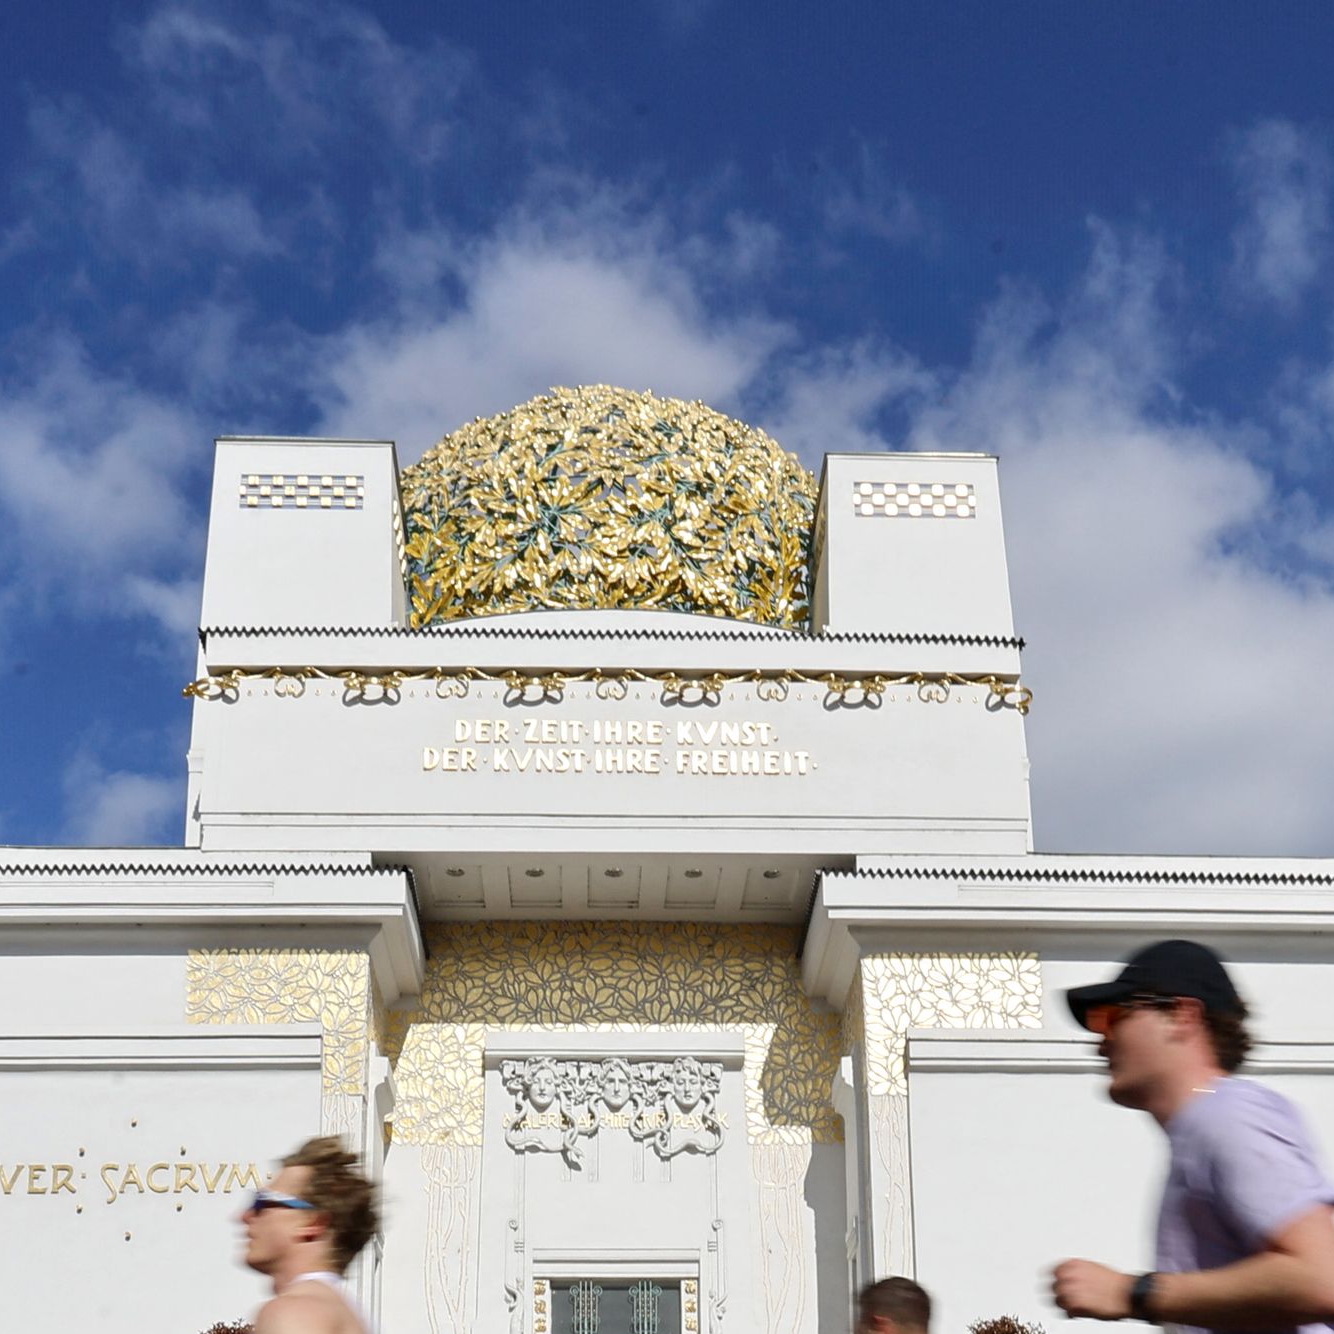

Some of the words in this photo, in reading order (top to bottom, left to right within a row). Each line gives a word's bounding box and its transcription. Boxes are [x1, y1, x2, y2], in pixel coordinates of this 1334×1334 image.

[454, 719, 510, 744] DER
[523, 719, 584, 745] ZEIT
[592, 720, 663, 745] IHRE
[423, 747, 478, 772] DER
[594, 748, 662, 774] IHRE
